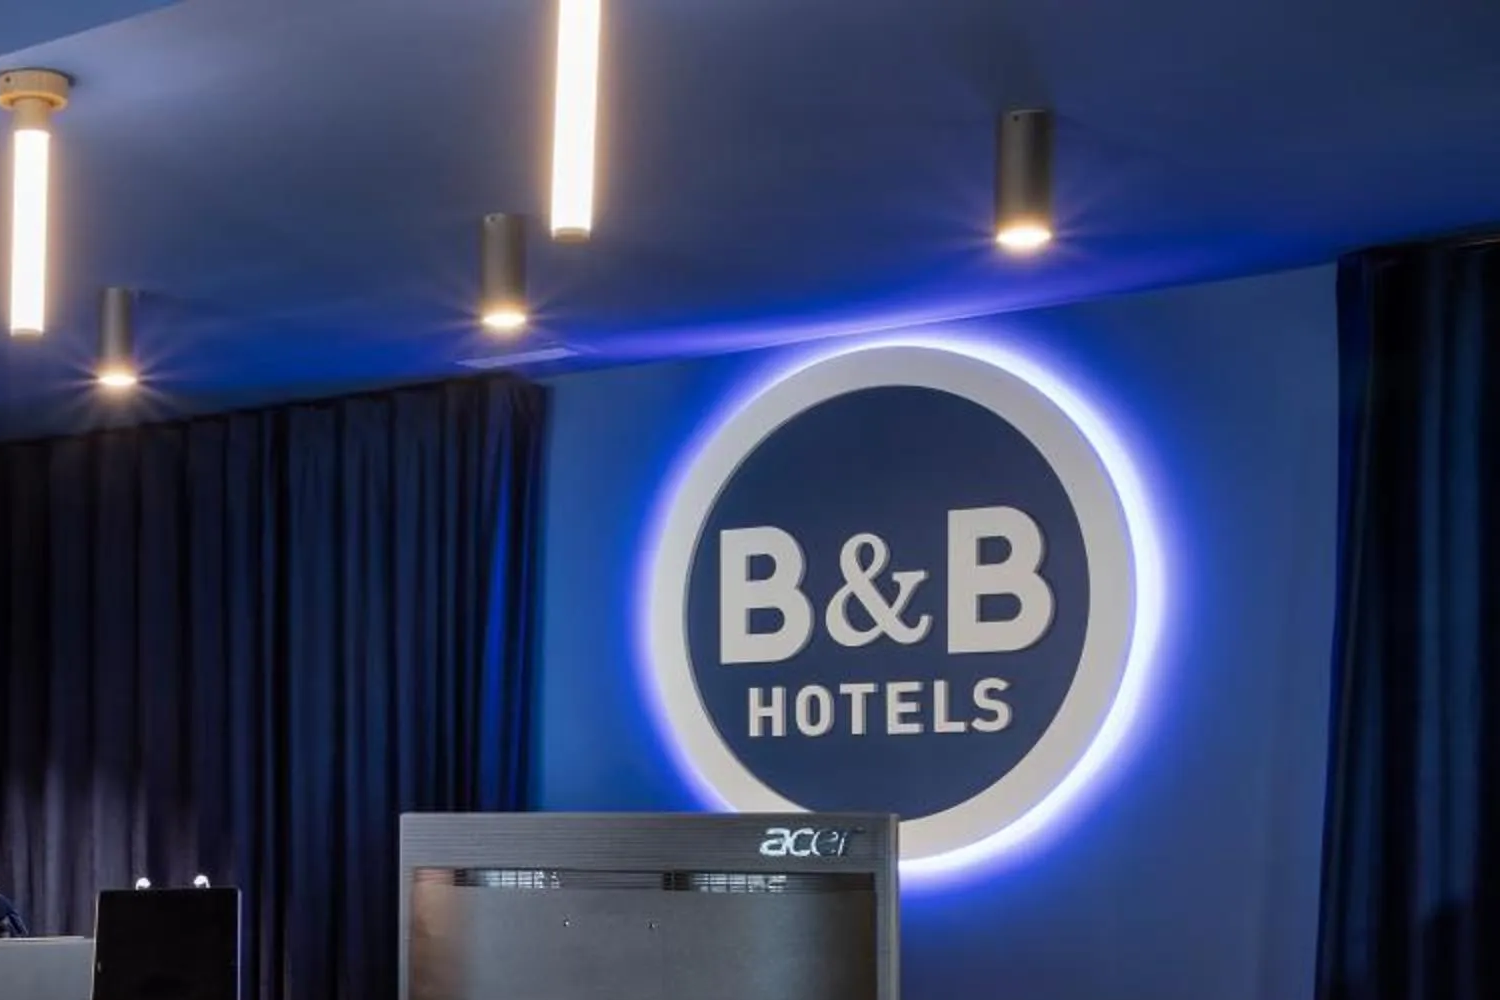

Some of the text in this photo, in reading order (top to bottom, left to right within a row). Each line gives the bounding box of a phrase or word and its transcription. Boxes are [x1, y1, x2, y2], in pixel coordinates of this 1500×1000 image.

[720, 505, 1055, 664] B&B
[748, 677, 1013, 737] HOTELS
[759, 826, 866, 857] acer
